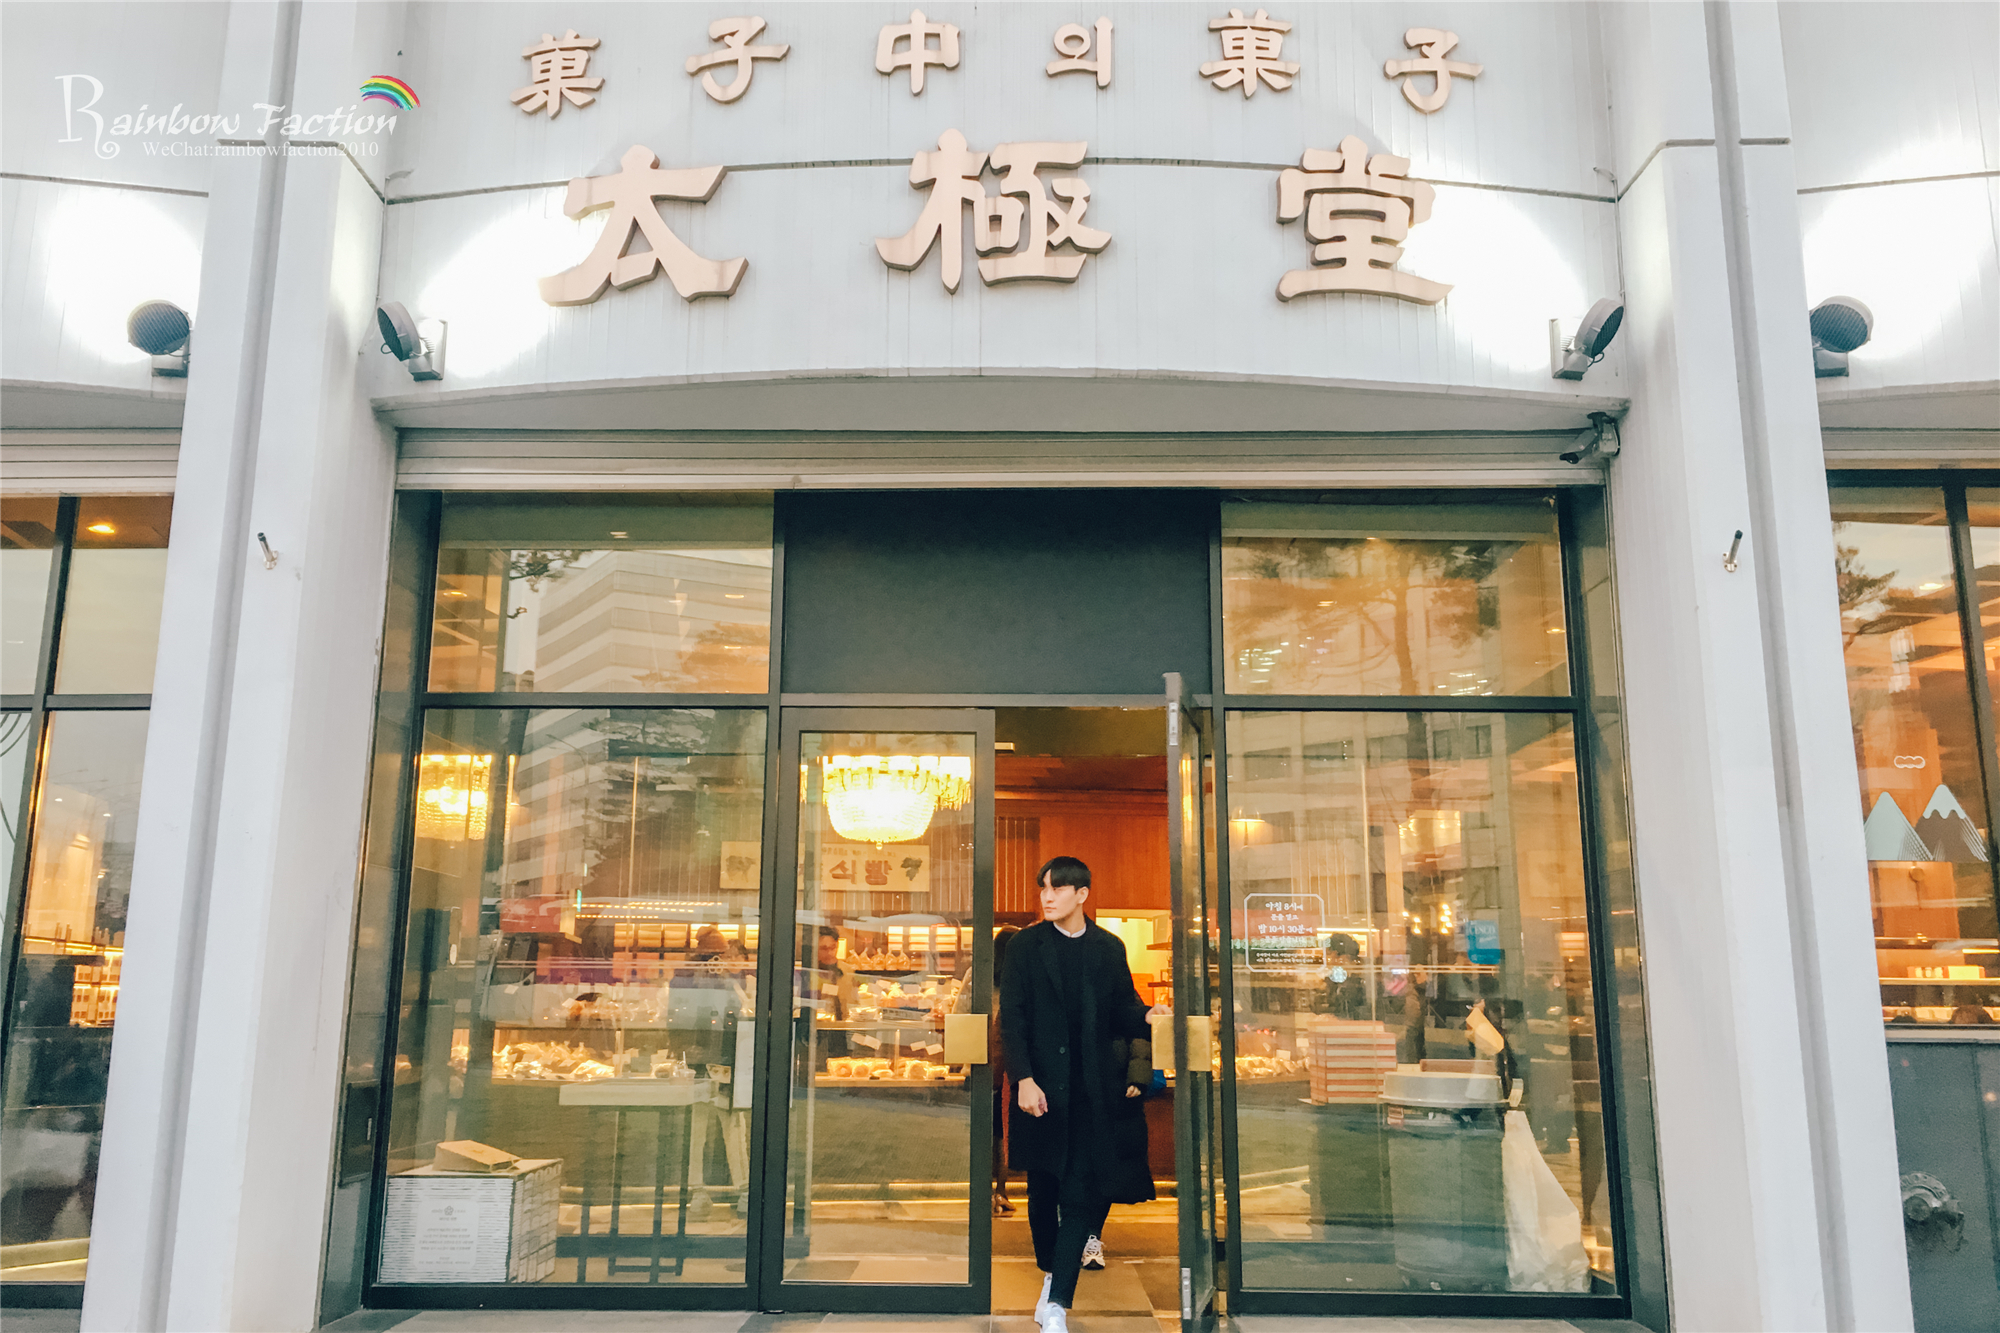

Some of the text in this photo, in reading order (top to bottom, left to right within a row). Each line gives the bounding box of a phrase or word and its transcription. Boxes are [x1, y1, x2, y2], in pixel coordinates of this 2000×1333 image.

[538, 128, 1454, 307] 太極堂
[1265, 902, 1304, 912] 아침 8시에
[1258, 923, 1313, 934] 밤 10시 30분에
